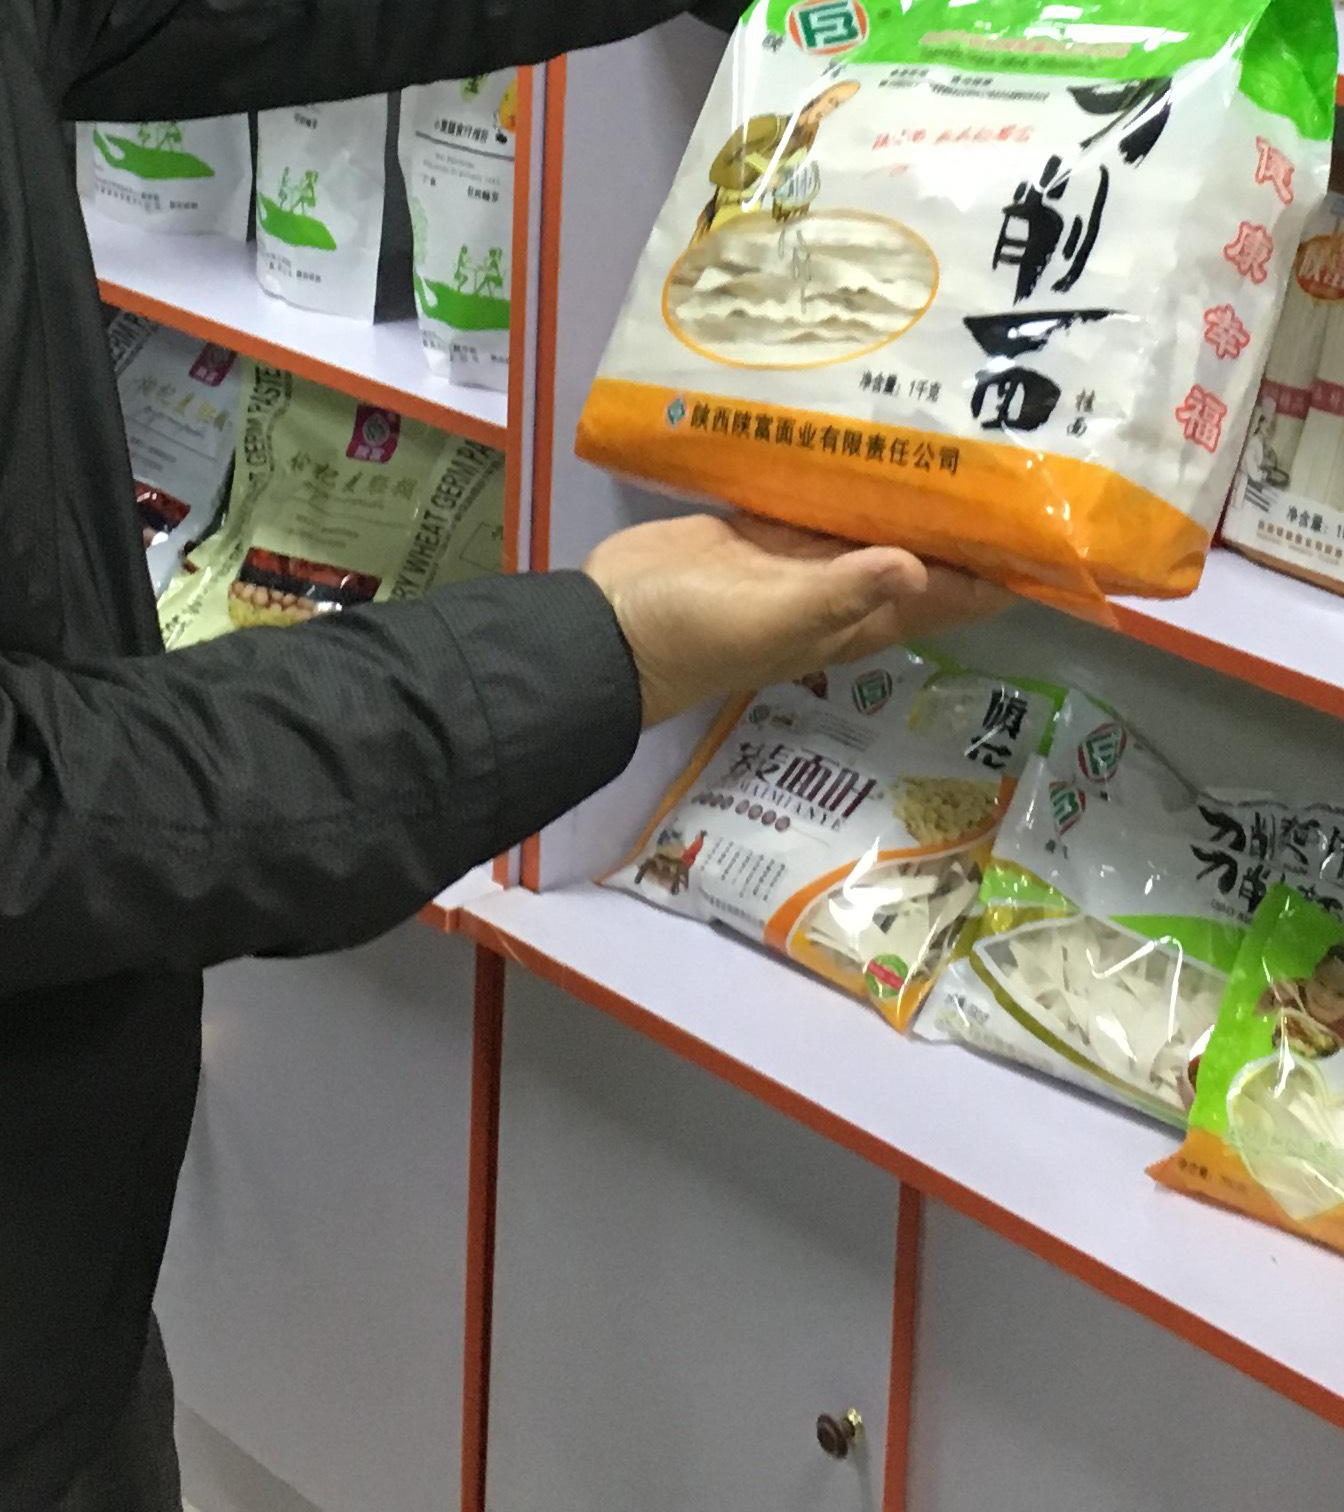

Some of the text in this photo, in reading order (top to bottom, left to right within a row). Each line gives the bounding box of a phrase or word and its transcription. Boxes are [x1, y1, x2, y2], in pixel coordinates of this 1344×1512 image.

[962, 76, 1172, 433] 刀削面
[690, 402, 961, 476] 陕西陕富面业有限责任公司
